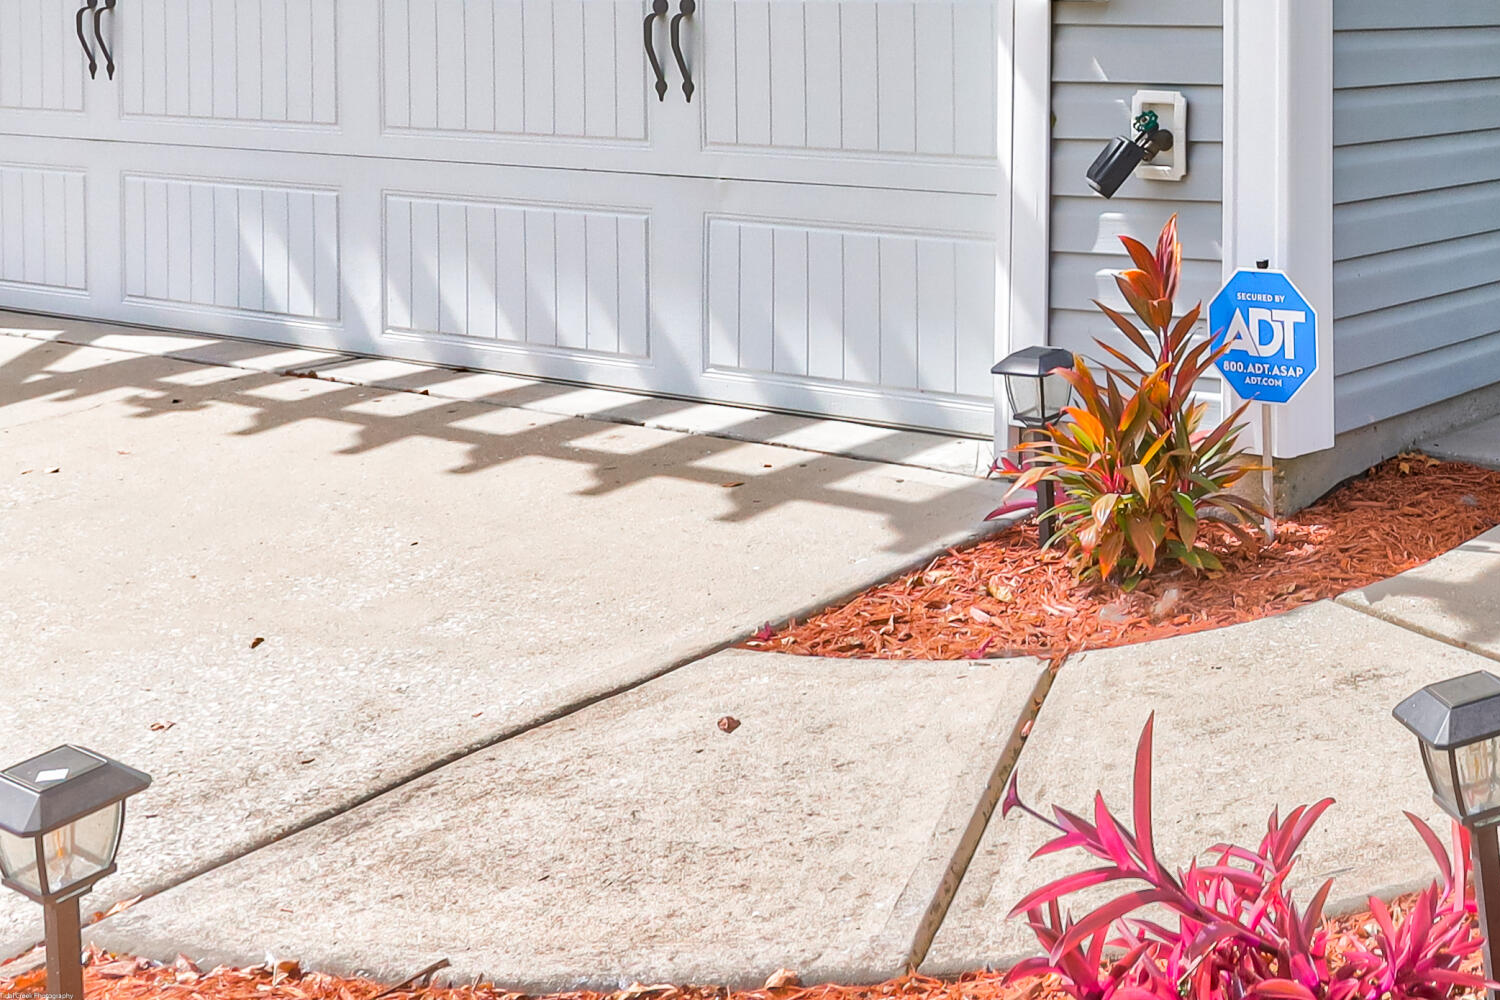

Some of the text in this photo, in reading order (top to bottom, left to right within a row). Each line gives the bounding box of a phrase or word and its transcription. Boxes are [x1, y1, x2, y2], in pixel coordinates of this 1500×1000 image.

[1236, 292, 1286, 303] SECURED BY
[1221, 307, 1306, 360] ADT
[1223, 360, 1304, 378] 800.ADT.ASAP
[1244, 376, 1283, 387] ADT.COM
